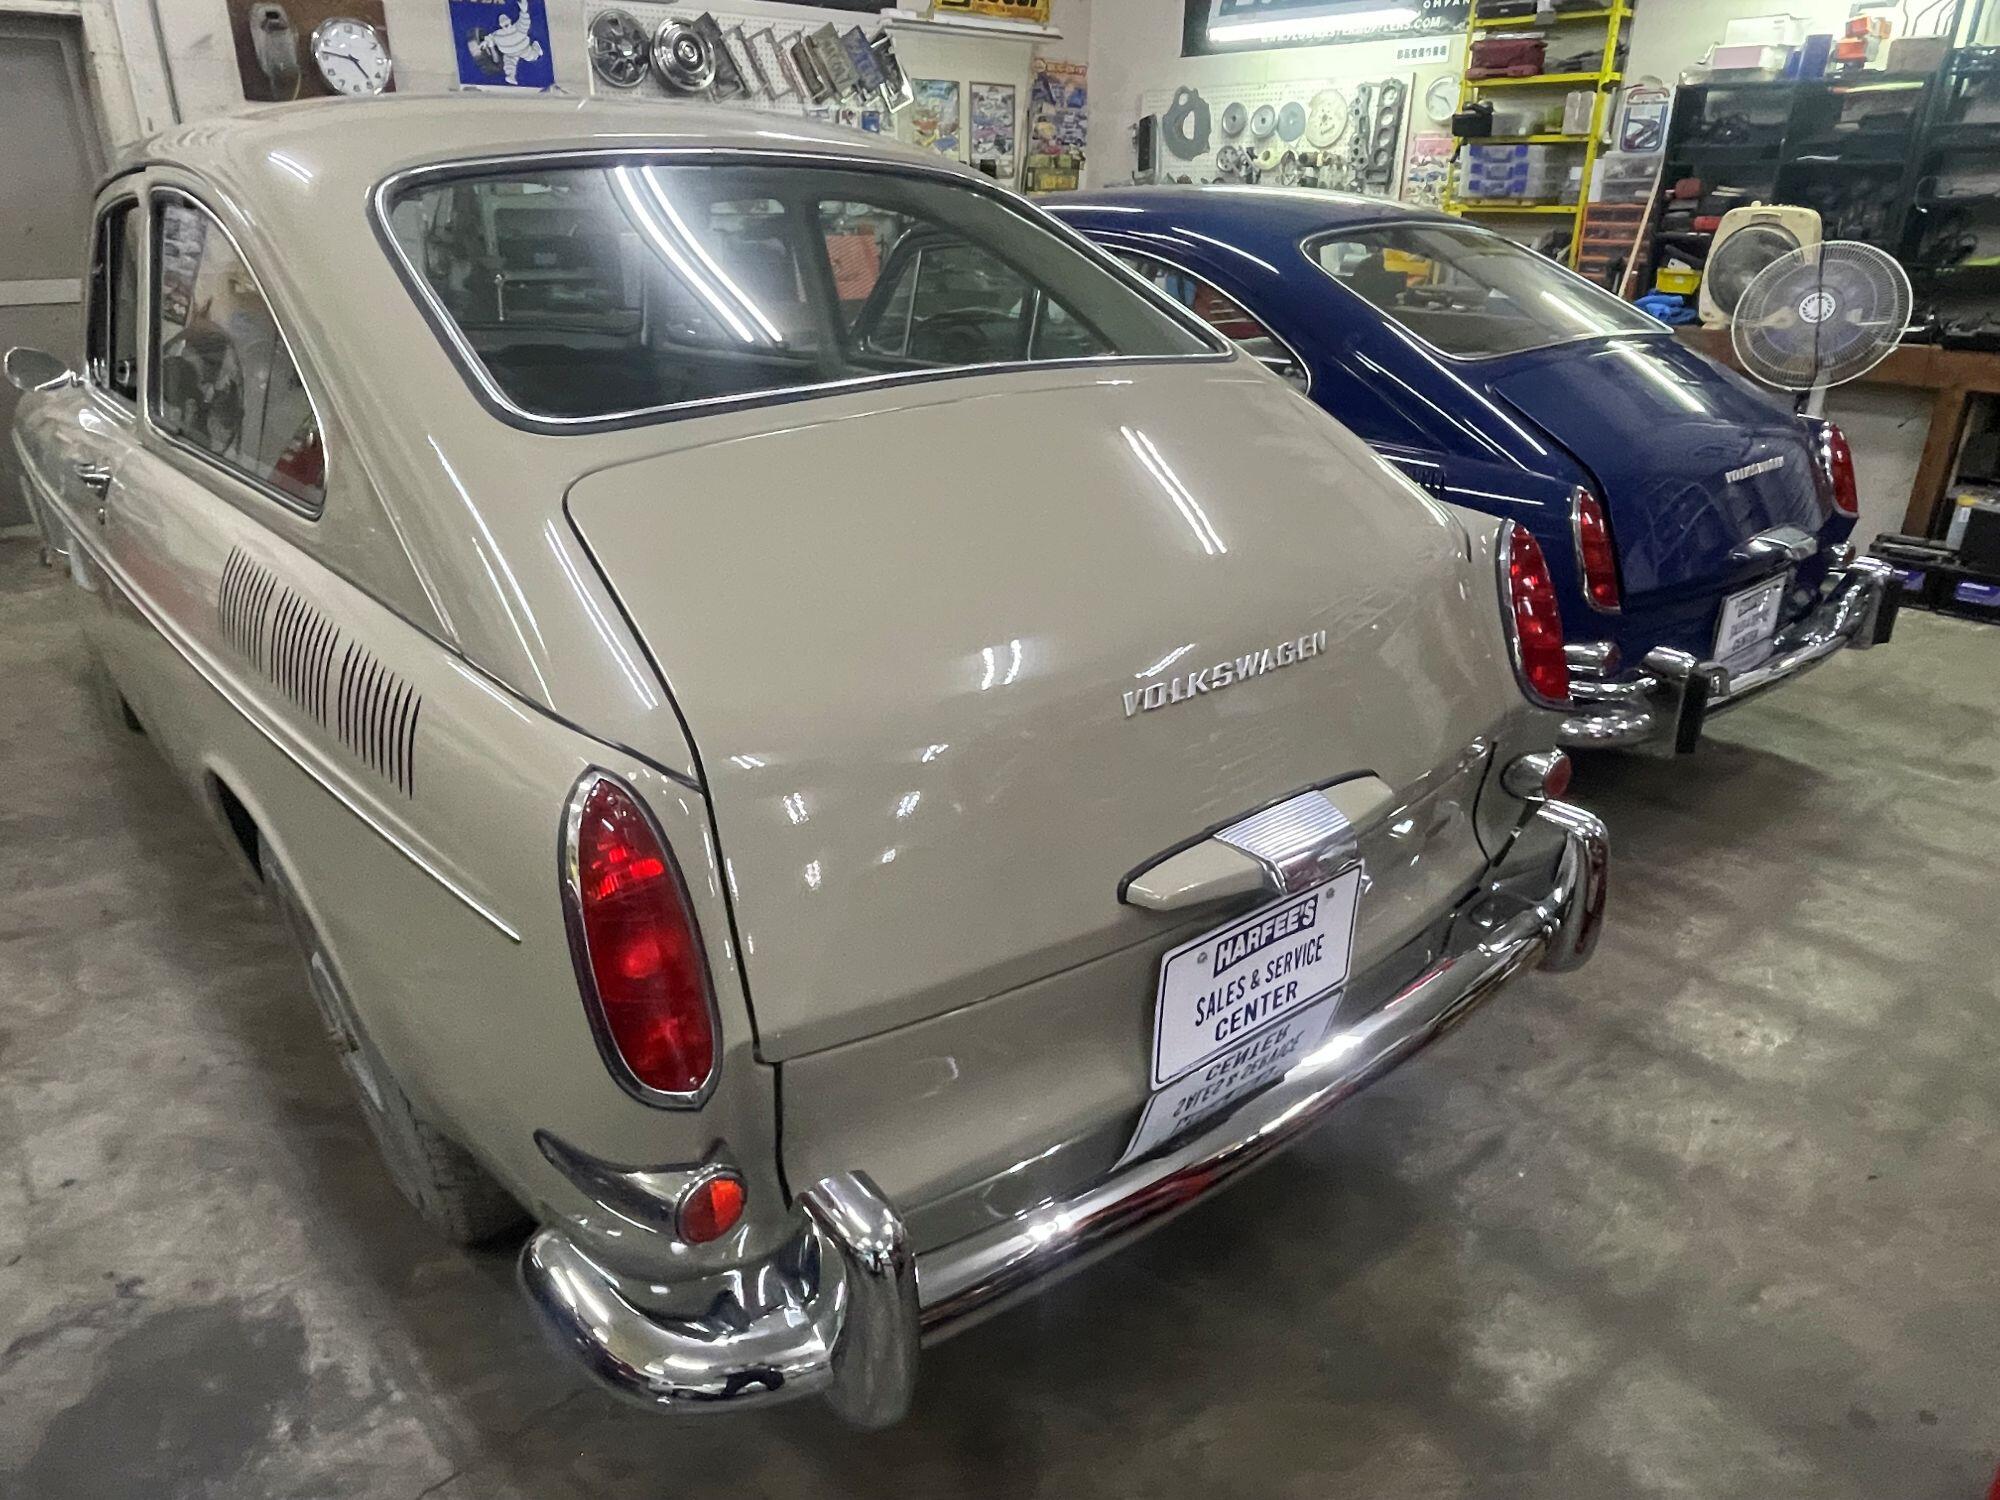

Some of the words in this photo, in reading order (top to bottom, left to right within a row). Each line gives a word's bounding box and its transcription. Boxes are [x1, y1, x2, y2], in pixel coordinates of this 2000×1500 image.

[1122, 630, 1326, 717] VOLKSWAGEN
[1215, 898, 1317, 976] HARFEE'S
[1195, 975, 1246, 1027] SALES
[1250, 968, 1261, 990] &
[1265, 933, 1325, 984] SERVICE
[1214, 980, 1298, 1042] CENTER
